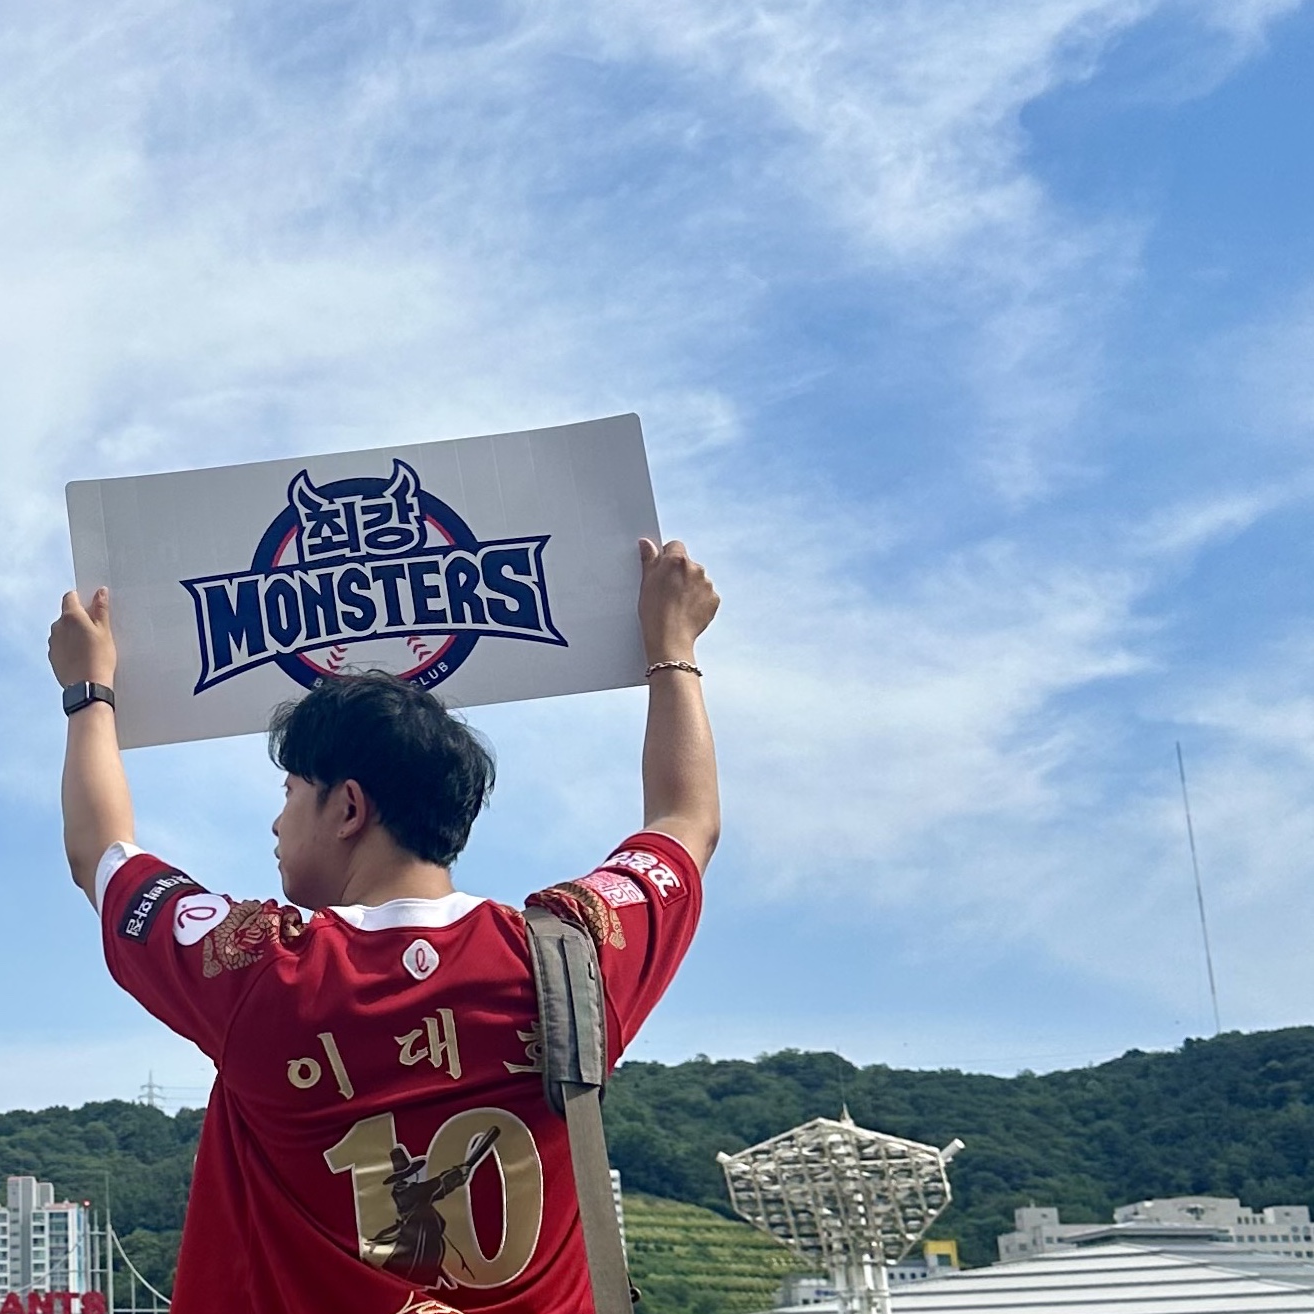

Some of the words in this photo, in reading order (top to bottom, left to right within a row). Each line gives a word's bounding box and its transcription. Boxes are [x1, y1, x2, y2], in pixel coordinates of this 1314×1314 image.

[298, 482, 419, 554] 최강
[203, 546, 544, 671] MONSTERS
[323, 1107, 544, 1290] 10
